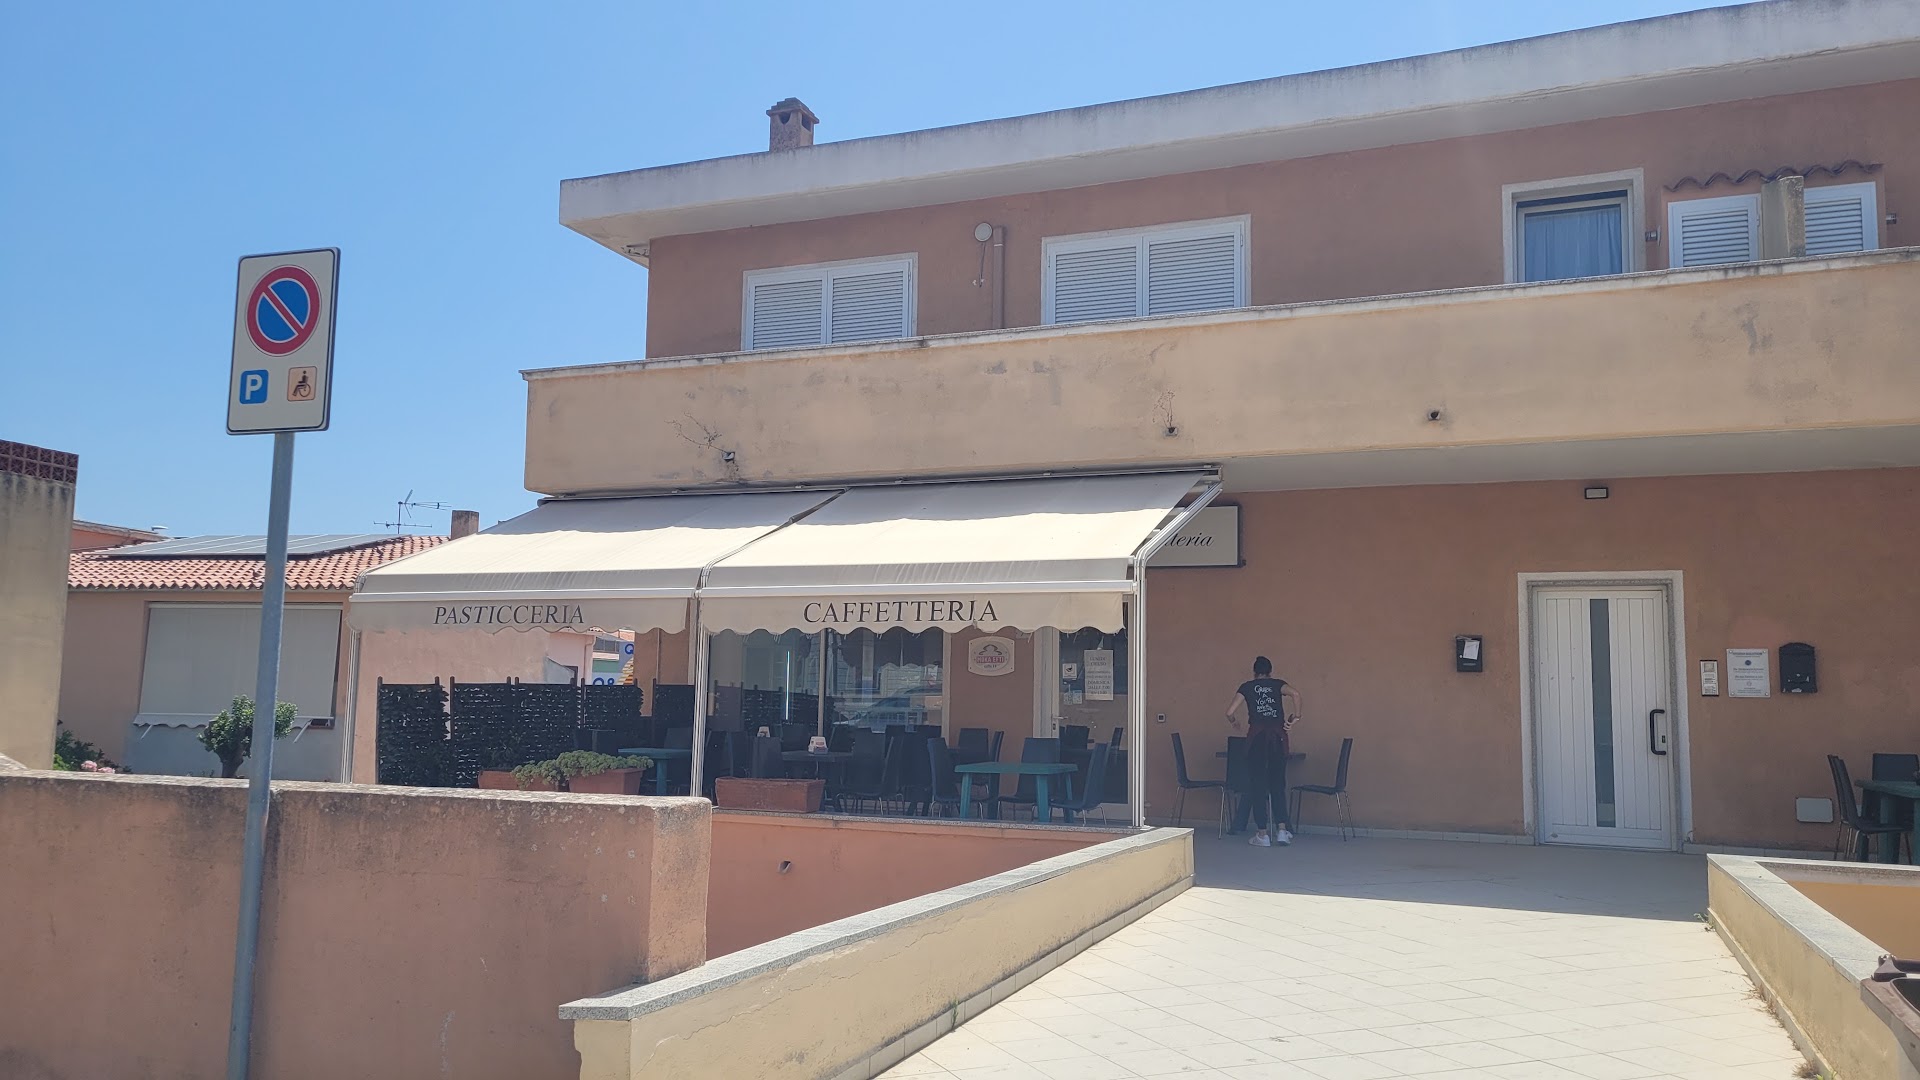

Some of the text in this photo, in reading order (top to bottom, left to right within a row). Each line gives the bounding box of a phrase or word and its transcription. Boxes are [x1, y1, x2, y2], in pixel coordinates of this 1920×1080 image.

[245, 374, 263, 400] P
[433, 604, 585, 625] PASTICCERIA
[803, 600, 999, 623] CAFFETTERIA
